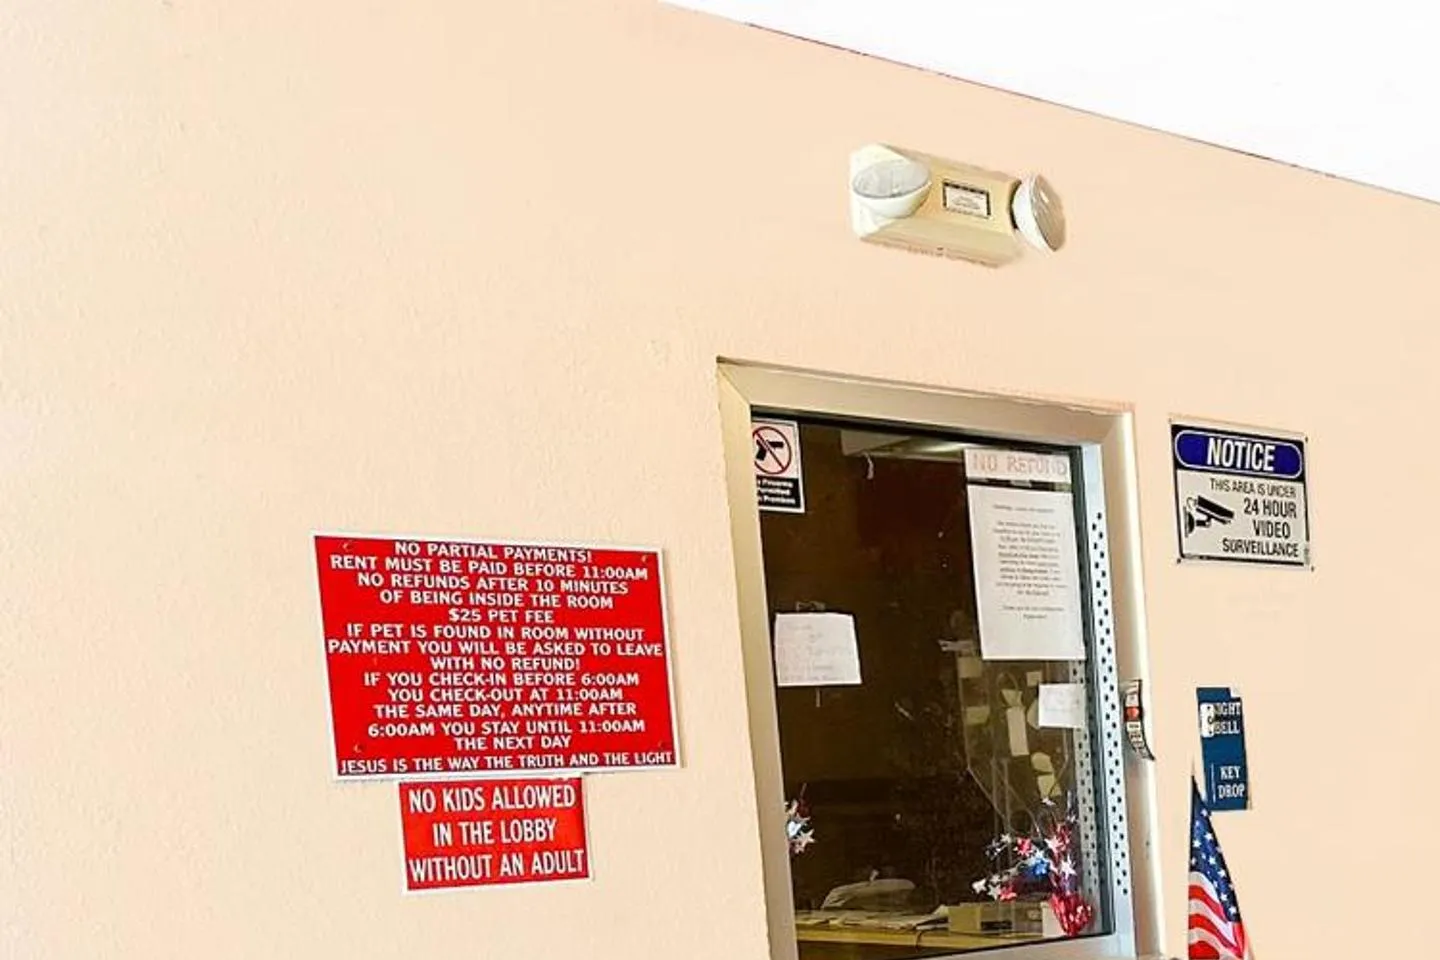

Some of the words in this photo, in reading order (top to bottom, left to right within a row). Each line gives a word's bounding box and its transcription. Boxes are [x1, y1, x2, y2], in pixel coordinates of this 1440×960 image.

[1207, 437, 1275, 471] NOTICE
[1210, 478, 1230, 492] THIS
[1232, 481, 1254, 494] AREA
[1257, 484, 1266, 495] IS
[1267, 485, 1296, 498] UNDER
[1244, 498, 1259, 515] 24
[1263, 499, 1297, 518] HOUR
[1253, 519, 1290, 539] VIDEO
[395, 542, 420, 556] NO
[428, 543, 497, 559] PARTIAL
[504, 547, 592, 563] PAYMENTS!
[1222, 538, 1299, 558] SURVEILLANCE
[330, 555, 377, 569] RENT
[385, 557, 432, 572] MUST
[440, 560, 462, 573] BE
[468, 561, 507, 575] PAID
[514, 563, 576, 577] BEFORE
[583, 566, 647, 580] 11:00AM
[358, 573, 384, 586] NO
[391, 574, 470, 589] REFUNDS
[476, 577, 528, 591] AFTER
[536, 580, 554, 592] 10
[561, 580, 628, 594] MINUTES
[380, 590, 404, 603] OF
[410, 590, 463, 605] BEING
[469, 592, 524, 606] INSIDE
[530, 594, 561, 607] THE
[568, 595, 613, 609] ROOM
[449, 608, 481, 622] $25
[488, 610, 518, 622] PET
[525, 610, 555, 623] FEE
[347, 623, 363, 637] IF
[371, 624, 404, 637] PET
[411, 625, 426, 638] IS
[434, 625, 491, 638] FOUND
[498, 626, 514, 639] IN
[522, 627, 568, 640] ROOM
[574, 628, 644, 641] WITHOUT
[328, 639, 410, 654] PAYMENT
[417, 640, 451, 654] YOU
[458, 641, 496, 654] WILL
[505, 642, 526, 654] BE
[533, 643, 585, 655] ASKED
[591, 643, 611, 655] TO
[617, 643, 662, 655] LEAVE
[430, 657, 474, 670] WITH
[481, 658, 505, 670] NO
[512, 658, 580, 671] REFUND!
[364, 672, 380, 686] IF
[387, 672, 422, 686] YOU
[429, 672, 506, 686] CHECK-IN
[514, 673, 576, 686] BEFORE
[581, 673, 639, 686] 6:00AM
[388, 689, 423, 702] YOU
[430, 688, 523, 701] CHECK-OUT
[530, 688, 549, 701] AT
[556, 688, 623, 700] 11:00AM
[374, 705, 409, 718] THE
[415, 704, 463, 718] SAME
[512, 703, 582, 716] ANYTIME
[589, 702, 636, 715] AFTER
[368, 723, 434, 737] 6:00AM
[441, 722, 474, 735] YOU
[482, 722, 519, 734] STAY
[526, 721, 572, 733] UNTIL
[579, 720, 645, 733] 11:00AM
[454, 737, 488, 751] THE
[494, 737, 534, 750] NEXT
[541, 735, 571, 749] DAY
[341, 759, 387, 773] JESUS
[393, 759, 408, 772] IS
[413, 757, 444, 771] THE
[447, 757, 480, 769] WAY
[485, 756, 513, 768] THE
[518, 754, 564, 767] TRUTH
[569, 754, 599, 766] AND
[604, 753, 630, 765] THE
[635, 751, 672, 764] LIGHT
[1221, 766, 1241, 780] KEY
[409, 789, 436, 813] NO
[443, 787, 485, 812] KIDS
[492, 785, 576, 810] ALLOWED
[1218, 783, 1245, 799] DROP
[433, 823, 452, 847] IN
[458, 821, 494, 845] THE
[501, 818, 557, 843] LOBBY
[409, 855, 493, 882] WITHOUT
[500, 853, 524, 877] AN
[532, 850, 584, 875] ADULT
